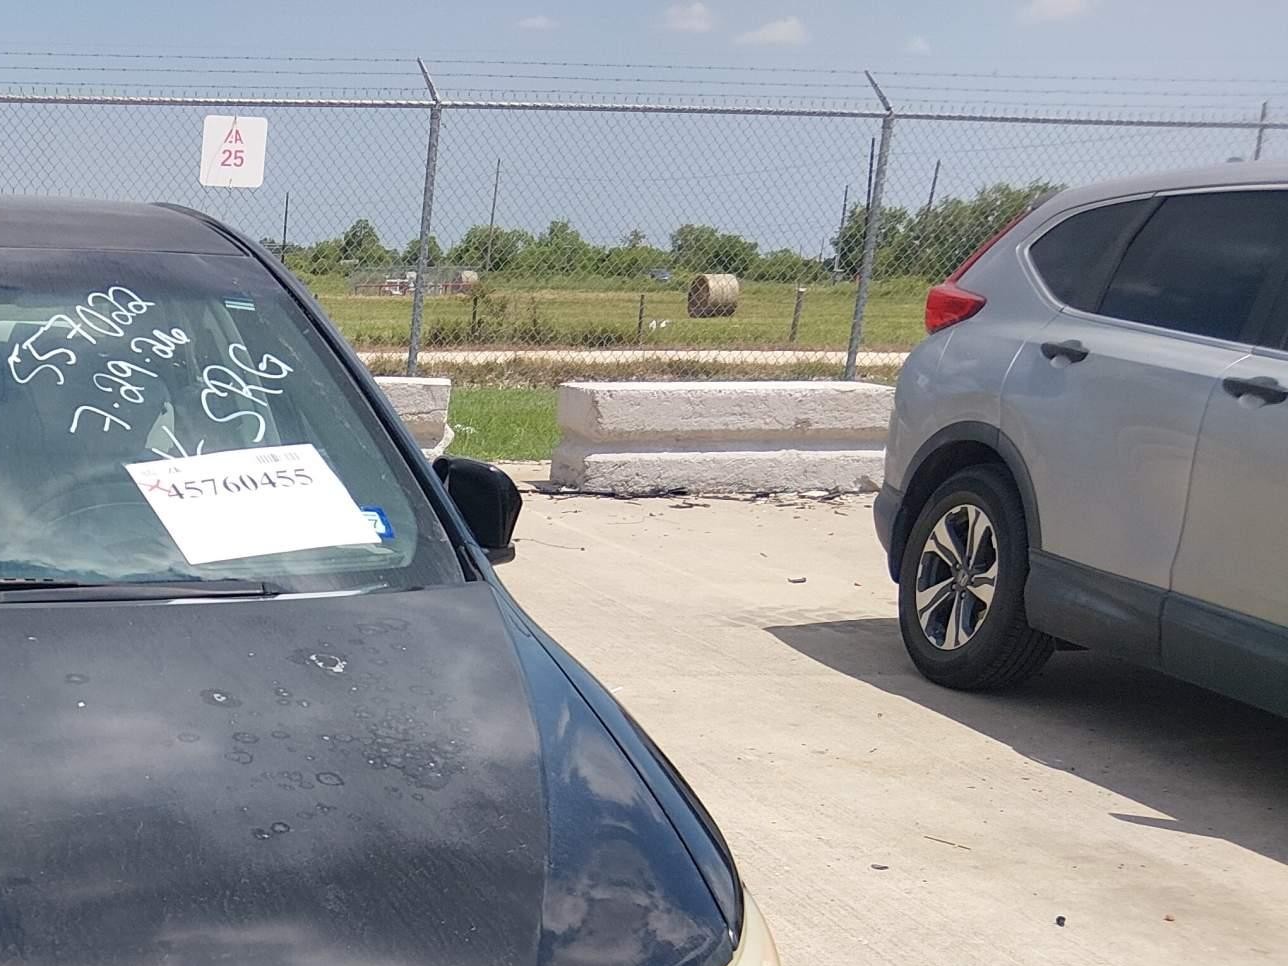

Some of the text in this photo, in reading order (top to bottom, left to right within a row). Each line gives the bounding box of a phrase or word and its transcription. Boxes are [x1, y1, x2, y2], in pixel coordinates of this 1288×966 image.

[220, 149, 245, 168] 25
[7, 285, 156, 386] 557022
[167, 467, 314, 500] 45760455
